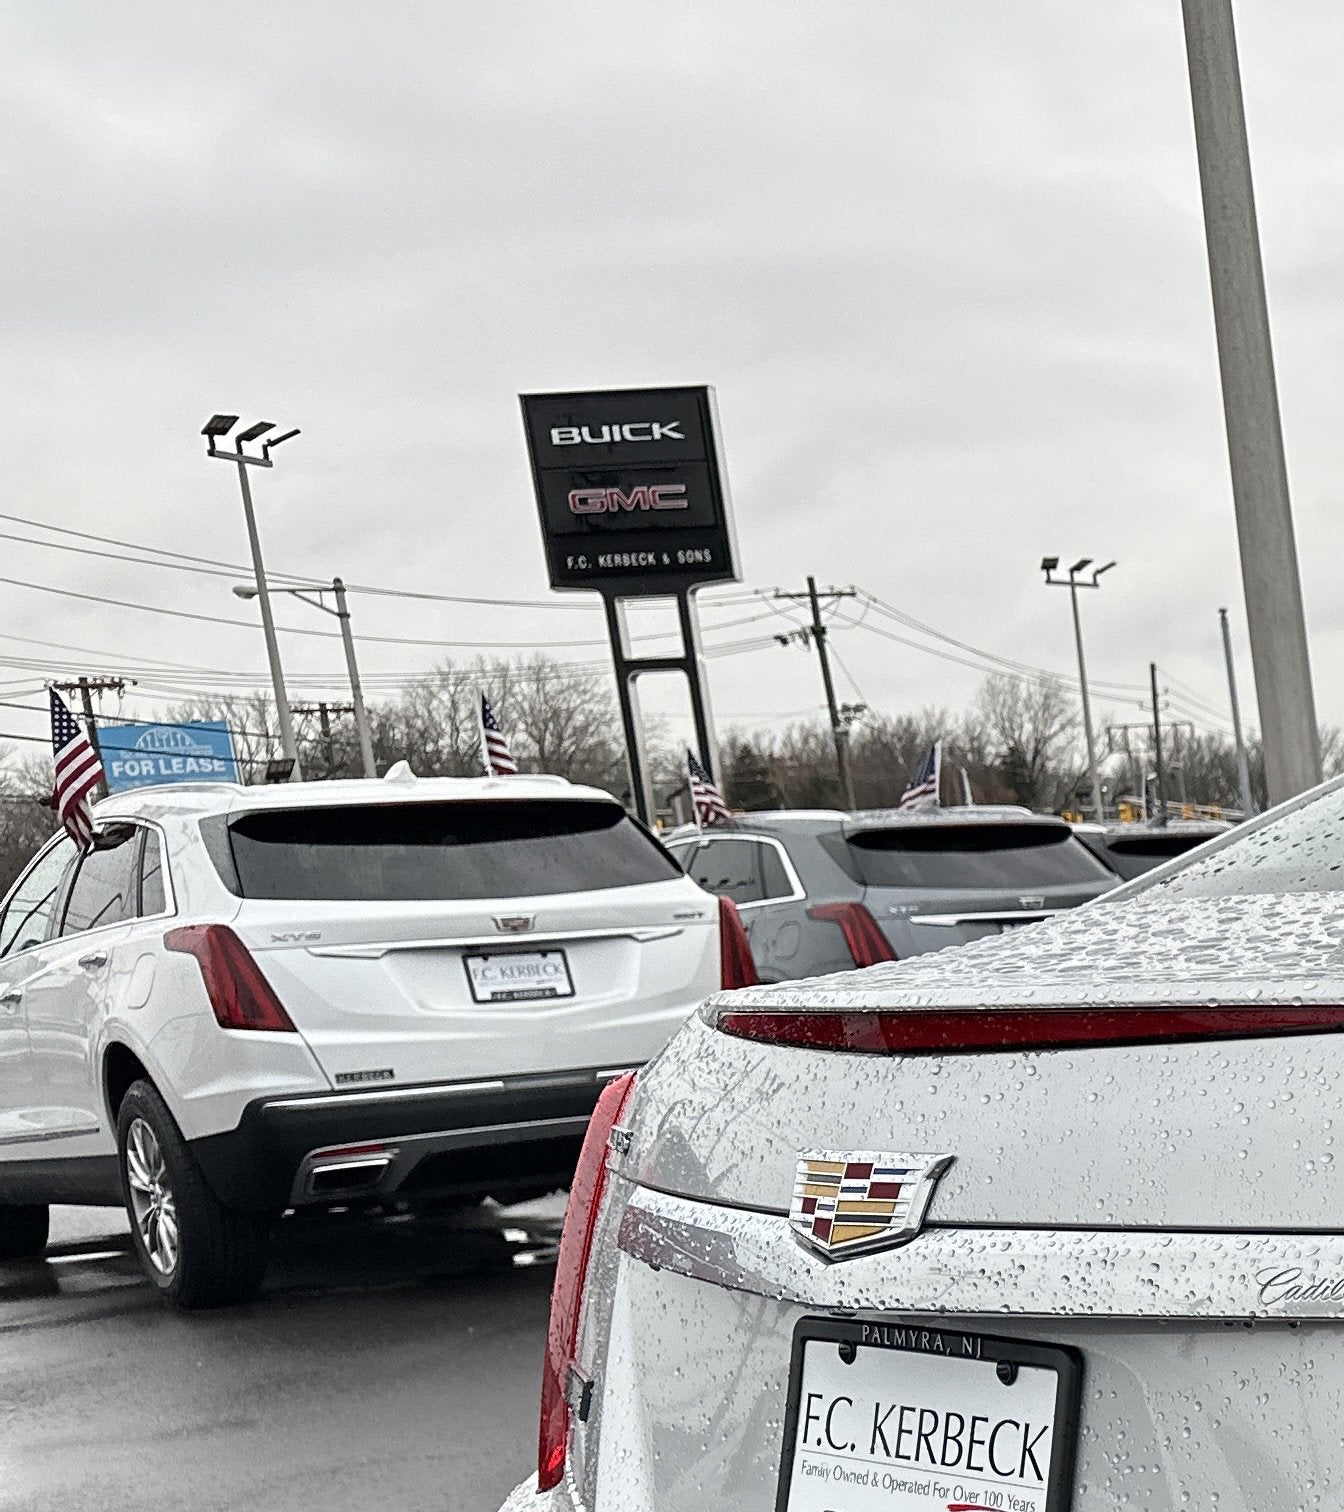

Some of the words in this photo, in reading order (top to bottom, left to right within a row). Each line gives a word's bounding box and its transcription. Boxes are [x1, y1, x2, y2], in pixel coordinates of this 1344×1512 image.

[550, 421, 685, 445] BUICK
[568, 484, 688, 514] GMC
[567, 554, 592, 569] F.C.
[598, 551, 656, 568] KERBECK
[662, 552, 670, 564] &
[677, 548, 712, 564] SONS
[111, 760, 155, 777] FOR
[159, 758, 226, 775] LEASE
[862, 1325, 951, 1356] PALMYRA,
[962, 1337, 983, 1358] NJ
[802, 1393, 856, 1452] F.C.
[870, 1402, 1049, 1481] KERBECK
[801, 1460, 830, 1482] Family
[833, 1465, 869, 1486] Owned
[871, 1472, 879, 1487] &
[882, 1473, 930, 1496] Operated
[933, 1482, 950, 1499] For
[953, 1485, 980, 1503] Over
[984, 1490, 1003, 1508] 100
[1008, 1494, 1035, 1512] Years
